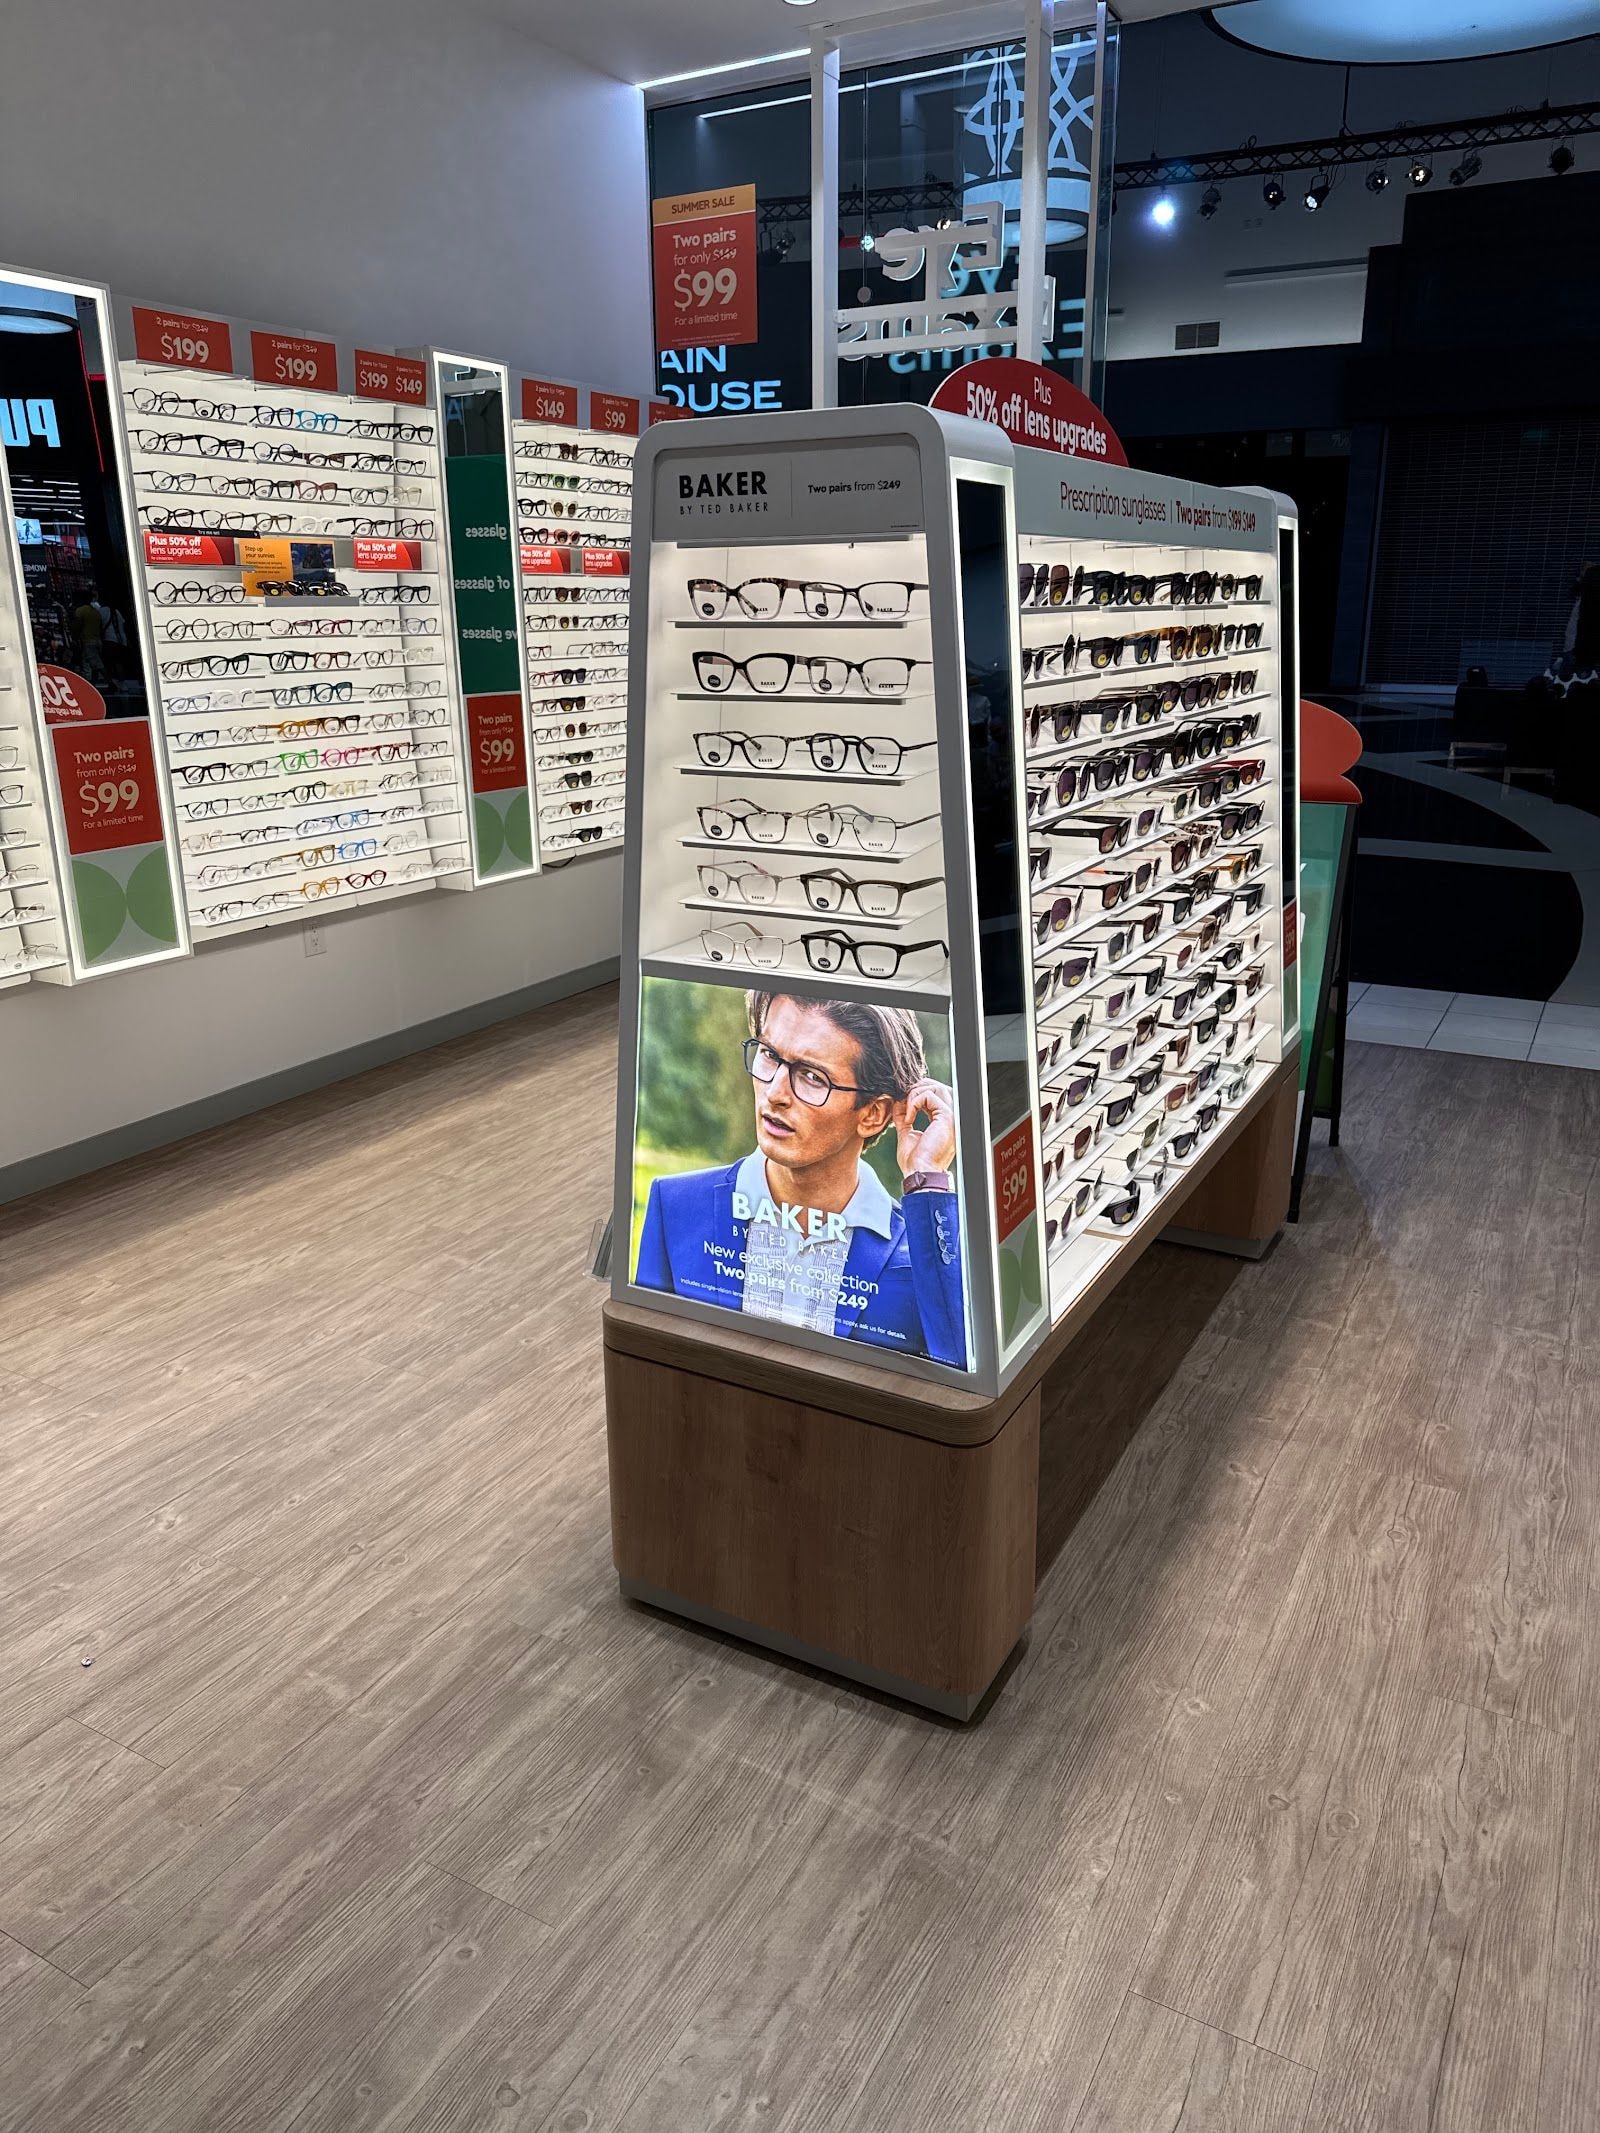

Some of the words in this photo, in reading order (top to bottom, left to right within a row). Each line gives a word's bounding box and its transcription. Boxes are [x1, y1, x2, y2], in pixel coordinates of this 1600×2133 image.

[671, 199, 710, 214] SUMMER
[712, 195, 735, 209] SALE
[672, 234, 700, 249] Two
[703, 227, 737, 248] pairs
[673, 254, 688, 266] for
[690, 251, 711, 264] only
[673, 267, 737, 312] $99
[156, 316, 162, 325] 2
[163, 319, 180, 329] pairs
[181, 321, 190, 330] for
[674, 316, 687, 326] For
[688, 317, 693, 325] a
[694, 312, 719, 324] limited
[720, 311, 738, 321] time
[161, 332, 209, 363] $199
[271, 339, 277, 348] 2
[276, 341, 292, 350] pairs
[293, 342, 301, 351] for
[275, 353, 318, 381] $199
[360, 368, 388, 389] $199
[395, 375, 423, 395] $149
[1033, 376, 1052, 405] Plus
[536, 396, 565, 419] $149
[966, 380, 998, 424] 50%
[1001, 392, 1022, 432] off
[1024, 399, 1051, 440] lens
[1052, 417, 1107, 455] upgrades
[605, 408, 626, 429] $99
[679, 471, 767, 498] BAKER
[807, 484, 827, 494] Two
[828, 482, 852, 494] pairs
[854, 481, 875, 491] from
[877, 479, 901, 491] $249
[680, 505, 692, 515] BY
[700, 504, 721, 514] TED
[729, 501, 768, 513] BAKER
[1060, 481, 1120, 520] Prescription
[1121, 493, 1166, 525] sunglasses
[1175, 500, 1192, 525] Two
[1193, 502, 1211, 531] pairs
[1212, 504, 1227, 529] from
[1242, 510, 1256, 533] $149
[148, 535, 168, 546] Plus
[168, 536, 187, 546] 50%
[188, 535, 202, 546] off
[150, 545, 167, 555] lens
[167, 545, 203, 557] upgrades
[356, 542, 371, 551] Plus
[371, 542, 386, 552] 50%
[386, 543, 397, 552] off
[357, 551, 370, 559] lens
[370, 552, 397, 562] upgrades
[478, 715, 494, 726] Two
[495, 713, 513, 725] pairs
[73, 751, 101, 764] Two
[104, 746, 135, 764] pairs
[480, 737, 515, 766] $99
[76, 768, 97, 779] from
[98, 766, 116, 777] only
[79, 778, 140, 818] $99
[83, 821, 96, 830] For
[96, 820, 102, 828] a
[102, 815, 127, 826] limited
[128, 814, 144, 823] time
[1001, 1147, 1013, 1162] Two
[1012, 1135, 1026, 1155] pairs
[1002, 1164, 1028, 1212] $99
[732, 1191, 848, 1244] BAKER
[732, 1225, 749, 1239] BY
[760, 1231, 787, 1247] TED
[798, 1241, 848, 1263] BAKER
[703, 1240, 735, 1260] New
[739, 1251, 803, 1275] exclusive
[806, 1267, 879, 1295] collection
[680, 1277, 700, 1288] Includes
[713, 1260, 745, 1280] Two
[749, 1271, 786, 1290] pairs
[789, 1278, 825, 1300] from
[829, 1288, 868, 1310] $249
[877, 1326, 886, 1334] for
